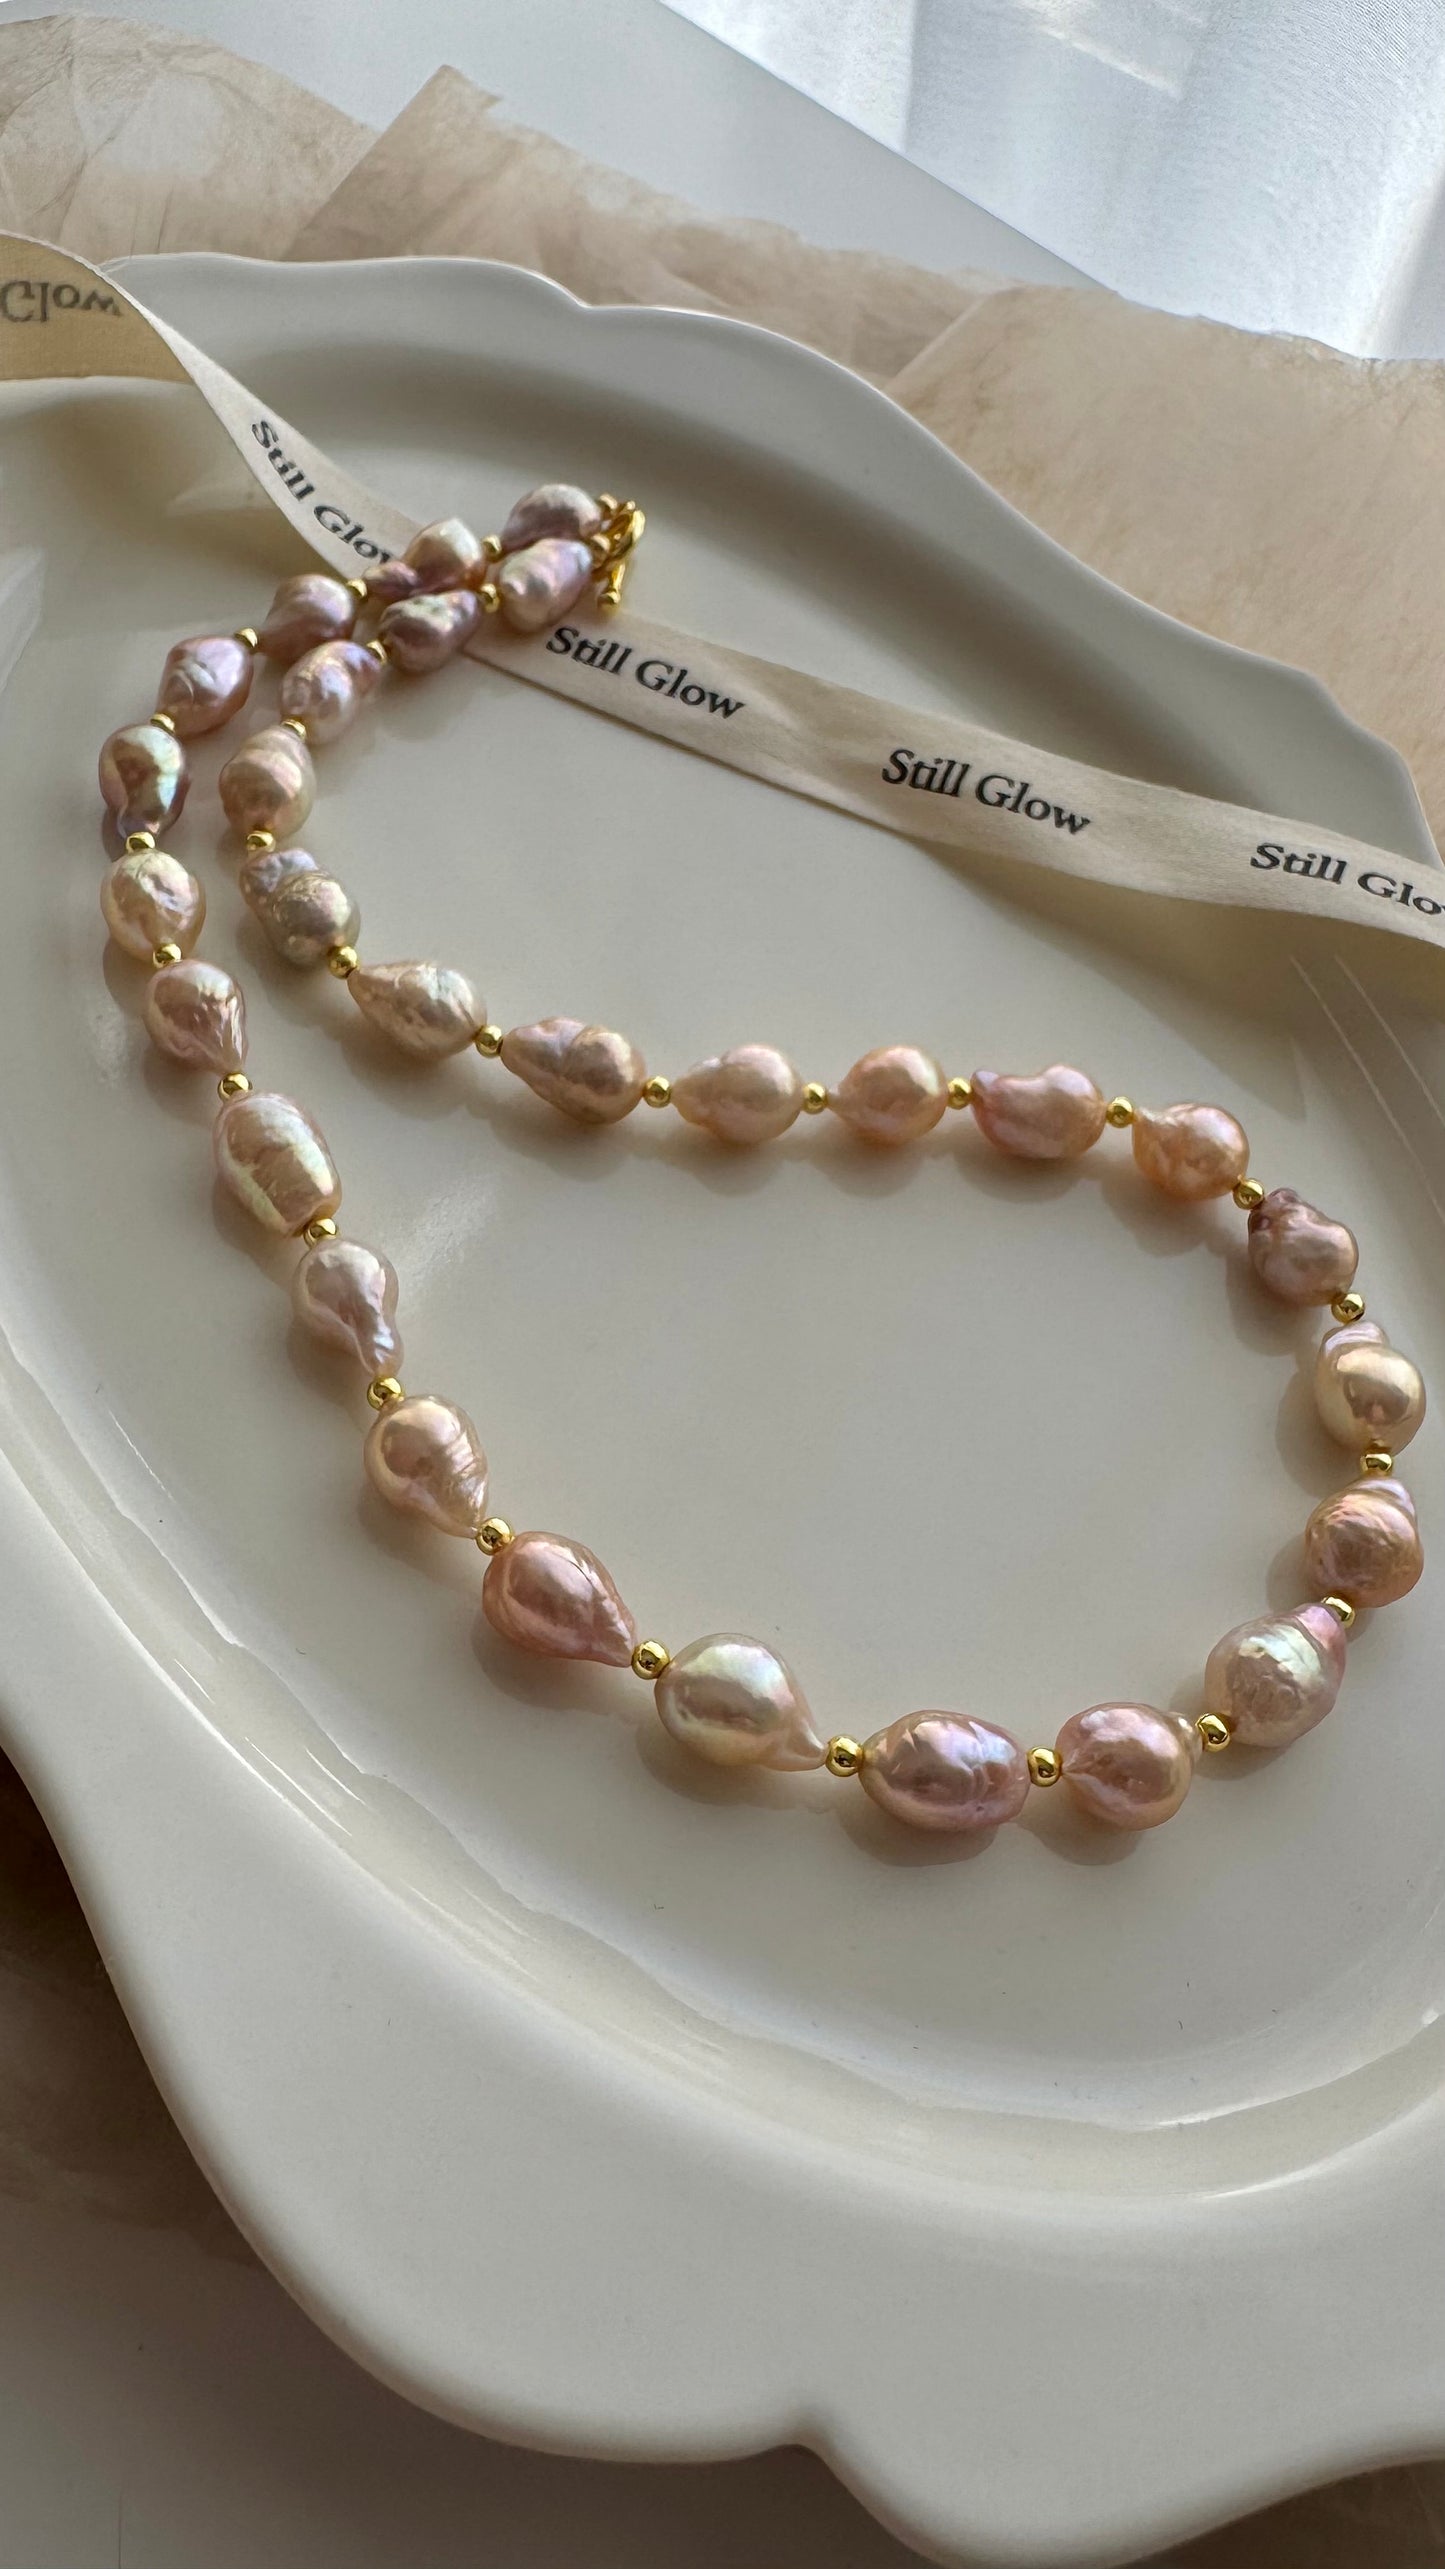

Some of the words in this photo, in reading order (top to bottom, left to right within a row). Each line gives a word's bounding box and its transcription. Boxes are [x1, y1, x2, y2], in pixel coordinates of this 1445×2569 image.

[251, 420, 315, 501] Still
[546, 627, 633, 676] Still
[635, 660, 746, 719] Glow
[882, 749, 972, 798] Still
[975, 774, 1092, 835] Glow
[1250, 842, 1347, 885] Still
[1357, 872, 1445, 915] Glo
